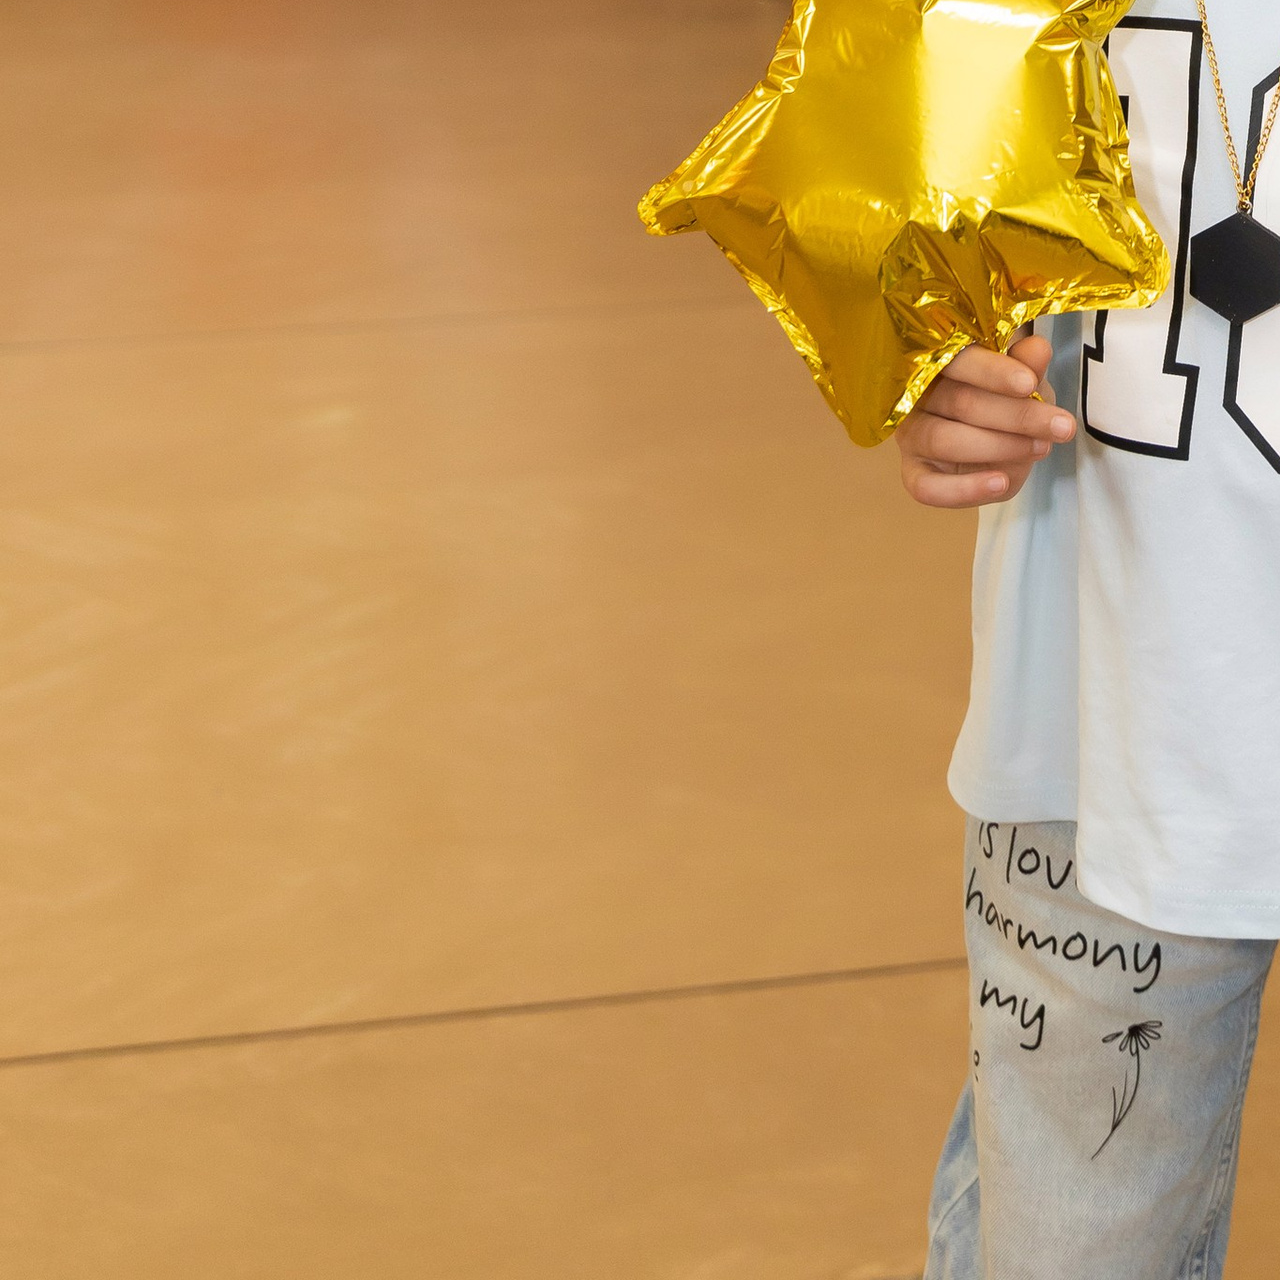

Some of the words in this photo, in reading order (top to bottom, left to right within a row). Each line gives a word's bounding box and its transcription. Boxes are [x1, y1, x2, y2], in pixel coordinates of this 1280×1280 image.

[1006, 825, 1078, 890] lov
[965, 867, 1161, 993] harmony
[979, 979, 1045, 1051] my
